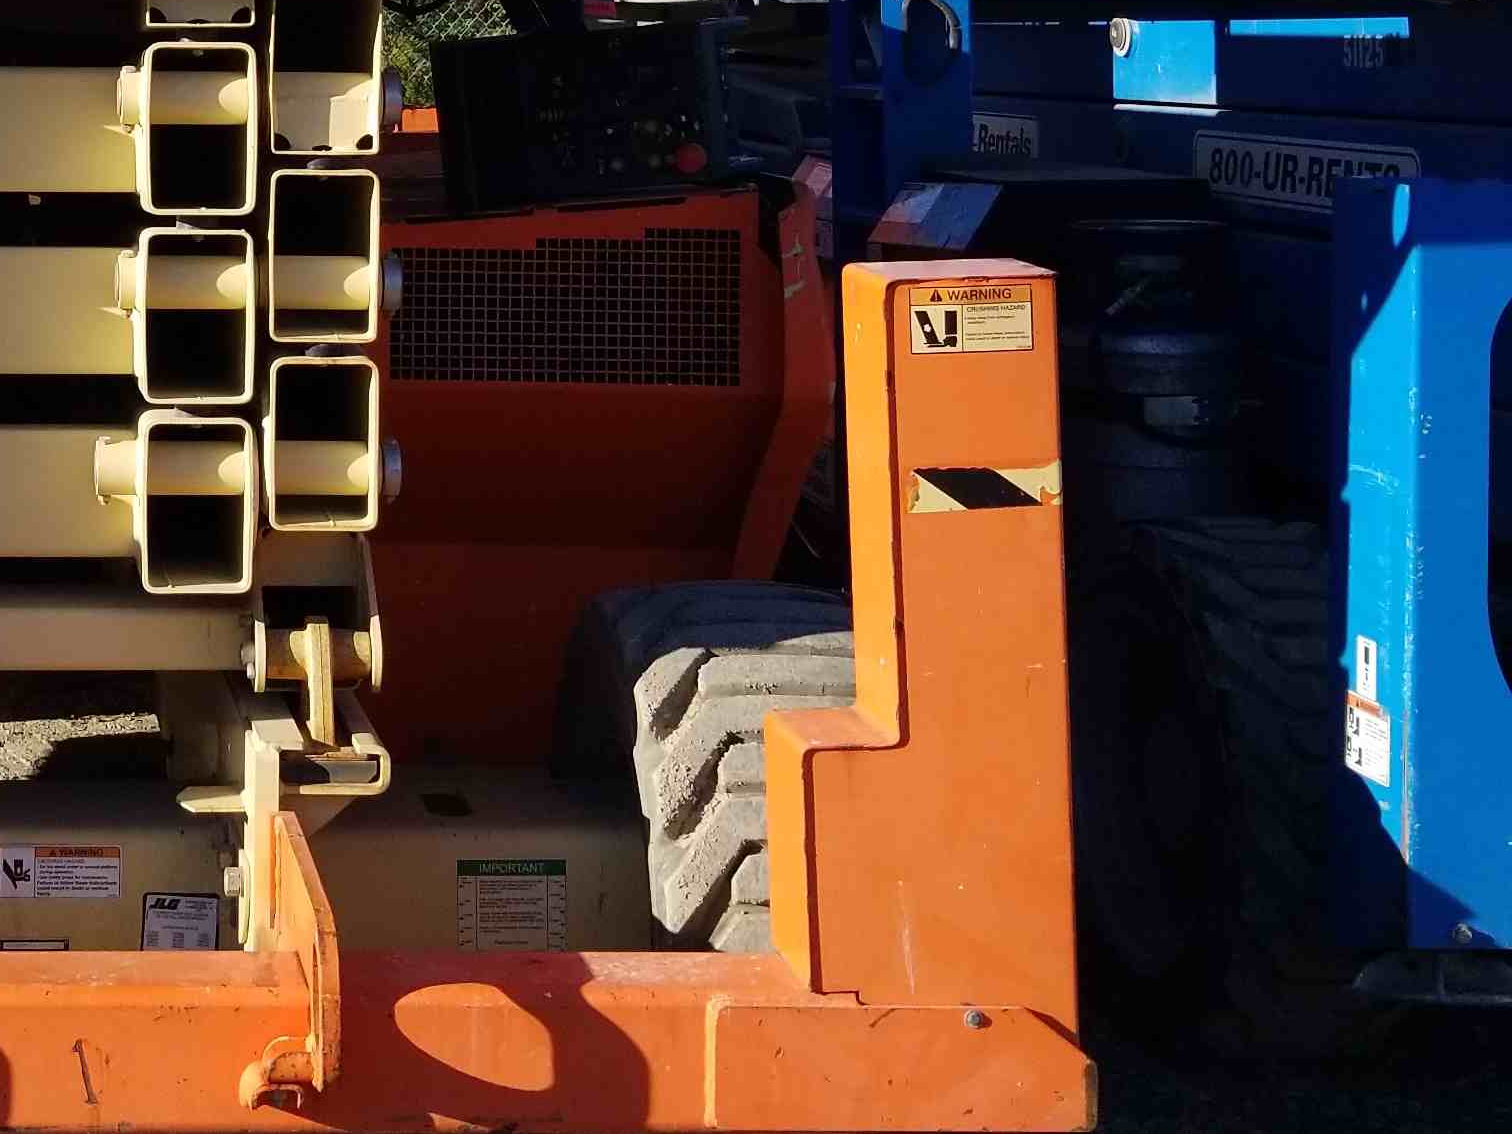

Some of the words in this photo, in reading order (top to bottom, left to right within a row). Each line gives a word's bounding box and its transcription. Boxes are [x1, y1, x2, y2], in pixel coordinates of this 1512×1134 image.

[947, 288, 1012, 301] WARNING
[1000, 304, 1026, 312] HAZARD
[479, 863, 545, 875] IMPORTANT
[148, 897, 181, 910] JLG
